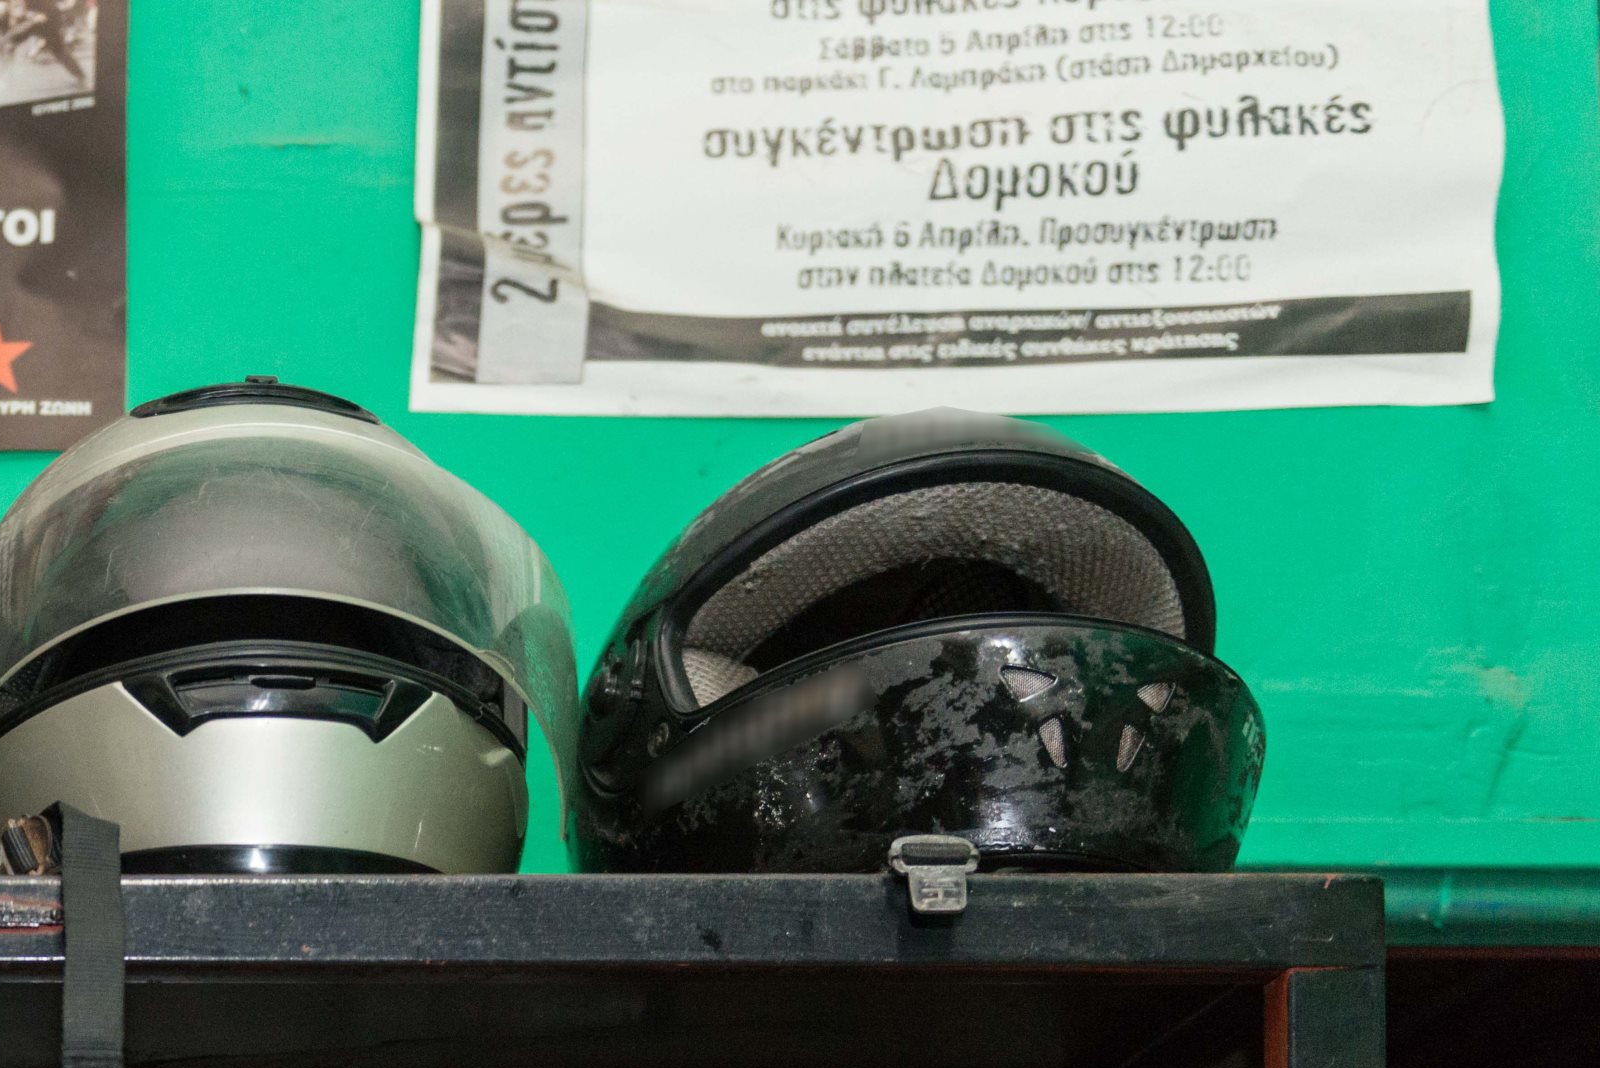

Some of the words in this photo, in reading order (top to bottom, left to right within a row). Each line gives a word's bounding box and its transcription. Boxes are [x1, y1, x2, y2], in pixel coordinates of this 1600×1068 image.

[818, 33, 932, 61] Σάββατο
[940, 34, 957, 55] 5
[967, 25, 1070, 54] Απρίλη
[1078, 21, 1132, 45] στις
[1145, 14, 1224, 40] 12:00
[492, 0, 561, 132] αντίσ
[711, 74, 755, 96] στο
[763, 66, 868, 96] παρκάκι
[877, 65, 900, 91] Γ.
[909, 57, 1048, 93] Λαμπράκη
[1056, 51, 1151, 82] (στάση
[1161, 43, 1341, 76] Δημαρχείου)
[702, 113, 1030, 168] συγκέντρωση
[1049, 107, 1144, 146] στις
[1164, 95, 1374, 151] φυλακές
[928, 149, 1140, 211] Δομοκού
[777, 219, 884, 253] Κυριακή
[894, 221, 910, 249] 6
[919, 218, 1030, 254] Απρίλη.
[1038, 214, 1278, 250] Προσυγκέντρωση
[491, 278, 559, 303] 2
[798, 265, 860, 290] στην
[868, 256, 971, 290] πλατεία
[980, 255, 1099, 291] Δομοκού
[1107, 258, 1159, 284] στις
[1173, 254, 1251, 284] 12:00
[39, 400, 93, 417] ΖΩΝΗ
